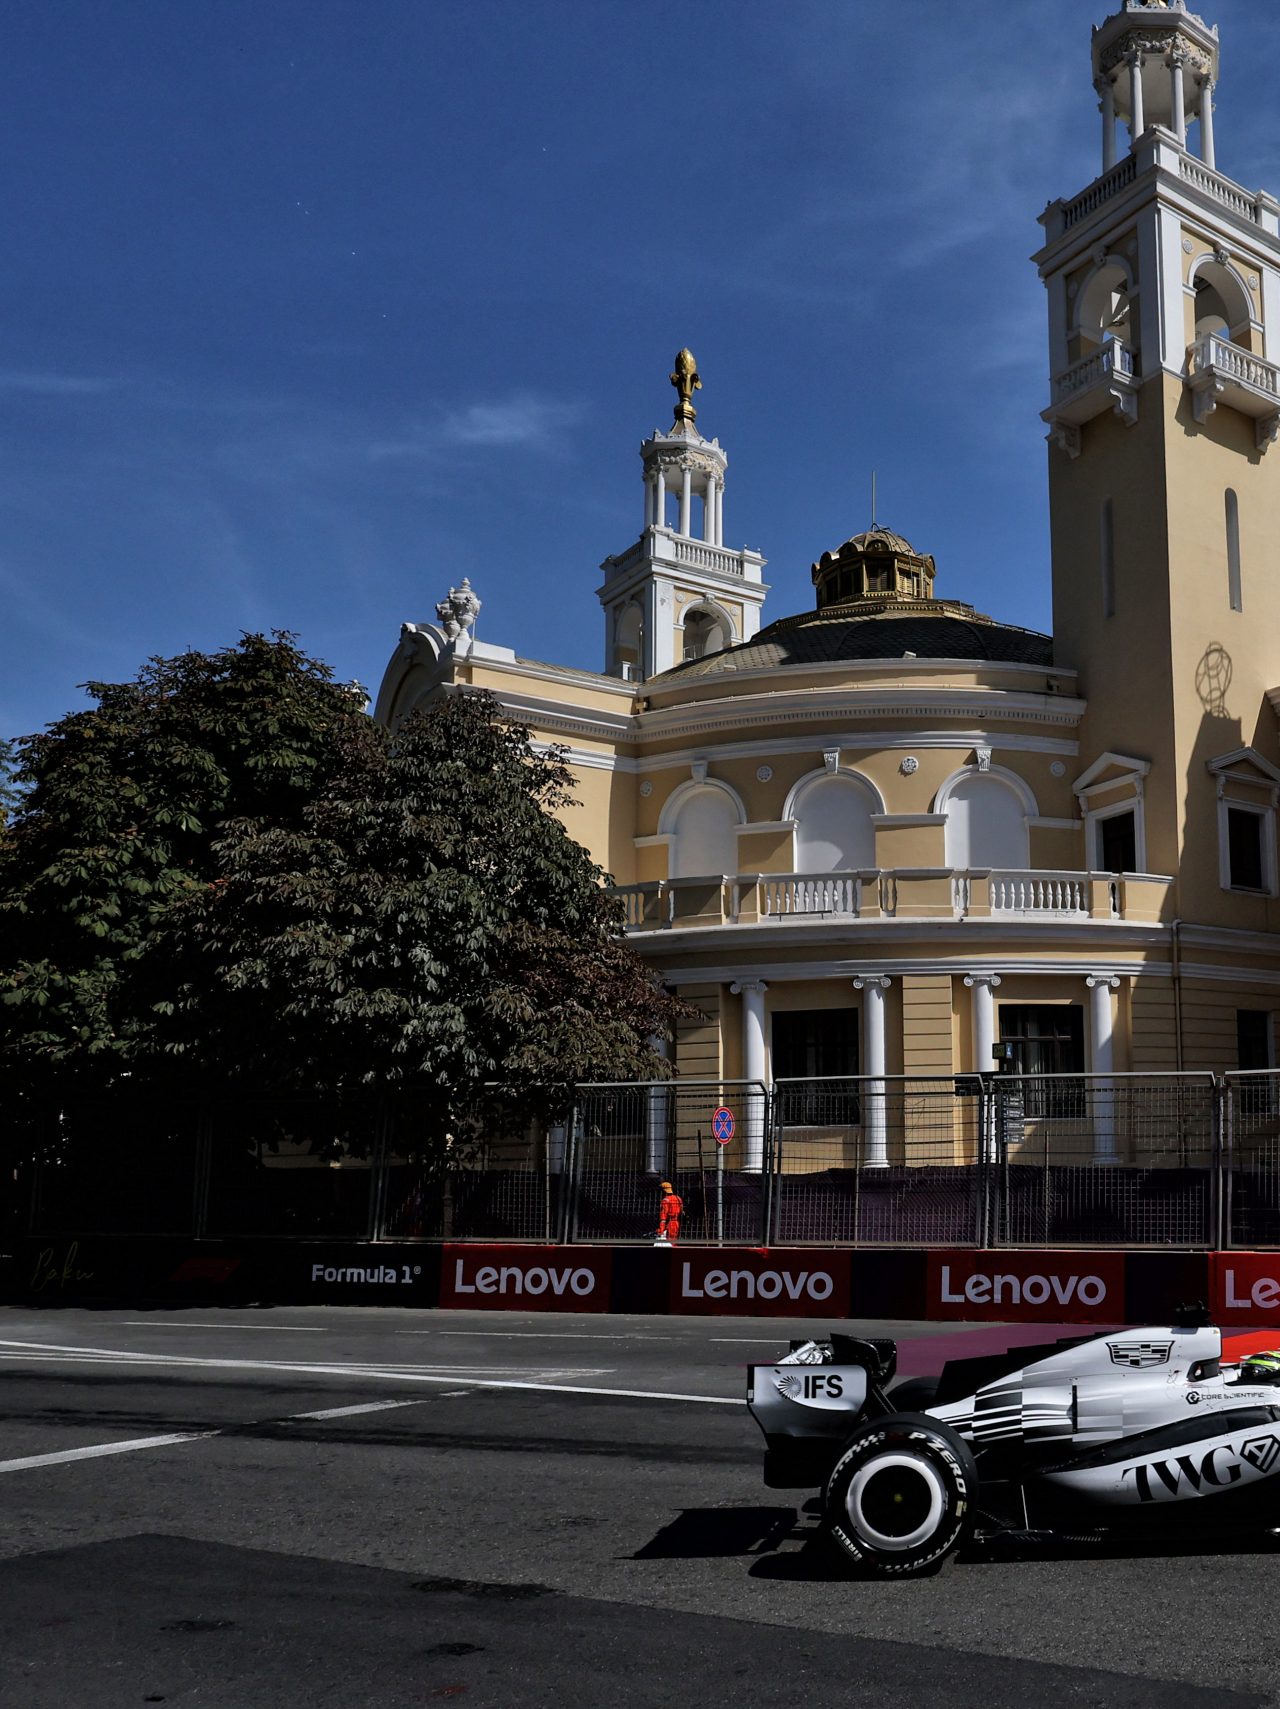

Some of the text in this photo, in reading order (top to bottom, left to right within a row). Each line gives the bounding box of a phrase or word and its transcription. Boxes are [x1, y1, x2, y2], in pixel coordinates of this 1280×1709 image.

[311, 1264, 397, 1283] Formula
[455, 1259, 595, 1296] Lenovo
[681, 1262, 834, 1300] Lenovo
[941, 1266, 1106, 1306] Lenovo
[804, 1374, 843, 1399] IFS
[1201, 1393, 1222, 1401] CORE
[909, 1431, 967, 1495] P ZERO
[1121, 1444, 1242, 1502] TWG
